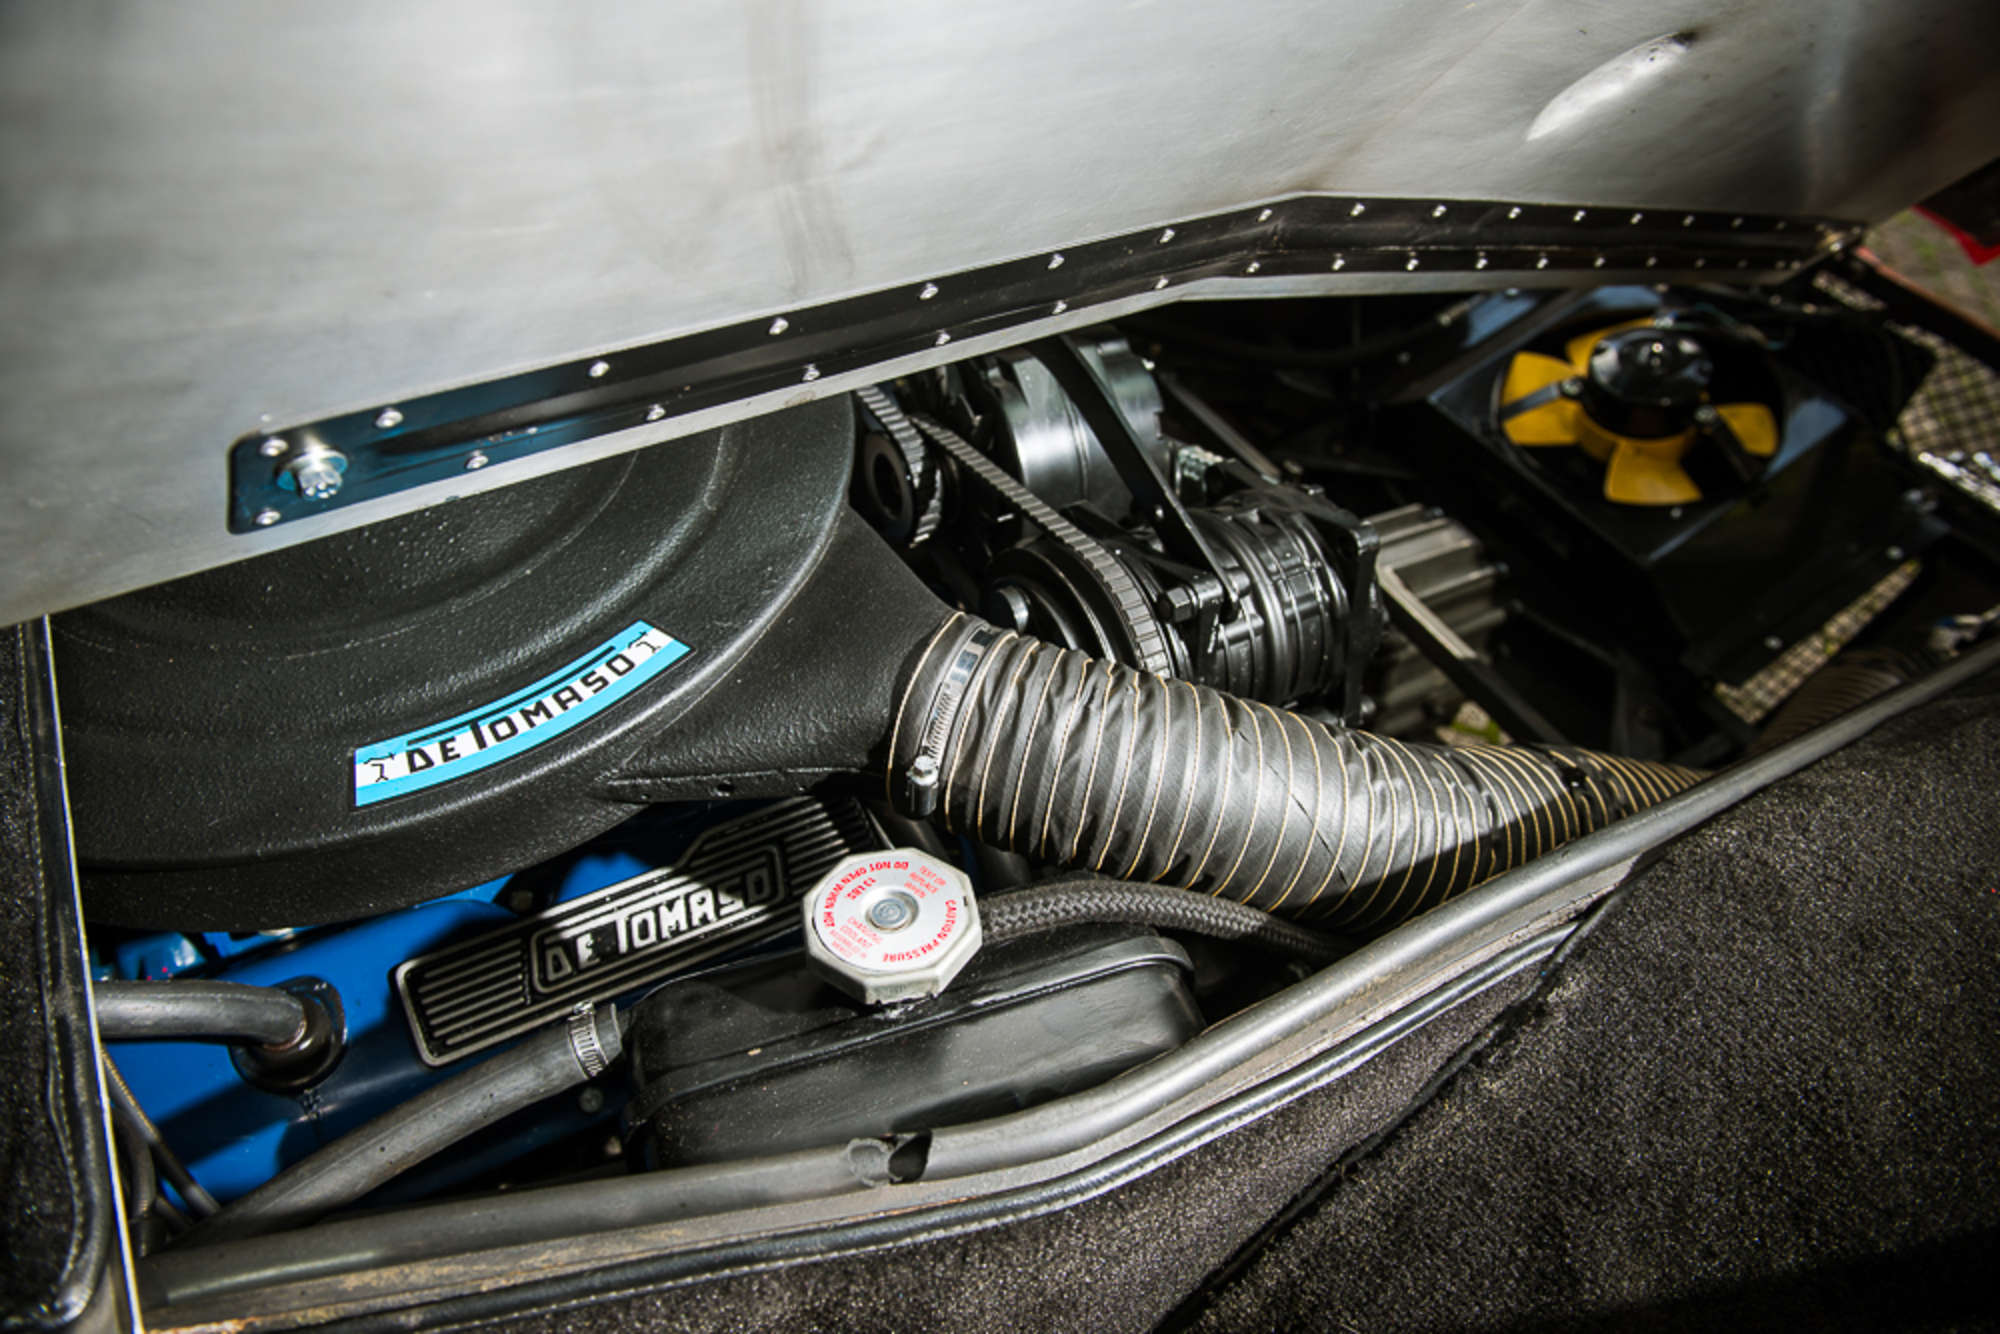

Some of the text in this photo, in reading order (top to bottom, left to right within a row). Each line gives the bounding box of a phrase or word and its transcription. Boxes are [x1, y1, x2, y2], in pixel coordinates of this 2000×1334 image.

[405, 737, 461, 773] DE
[869, 860, 891, 872] NOT
[893, 860, 909, 870] DO
[823, 911, 836, 928] HOT
[883, 899, 958, 963] CAUTION PRESSURE
